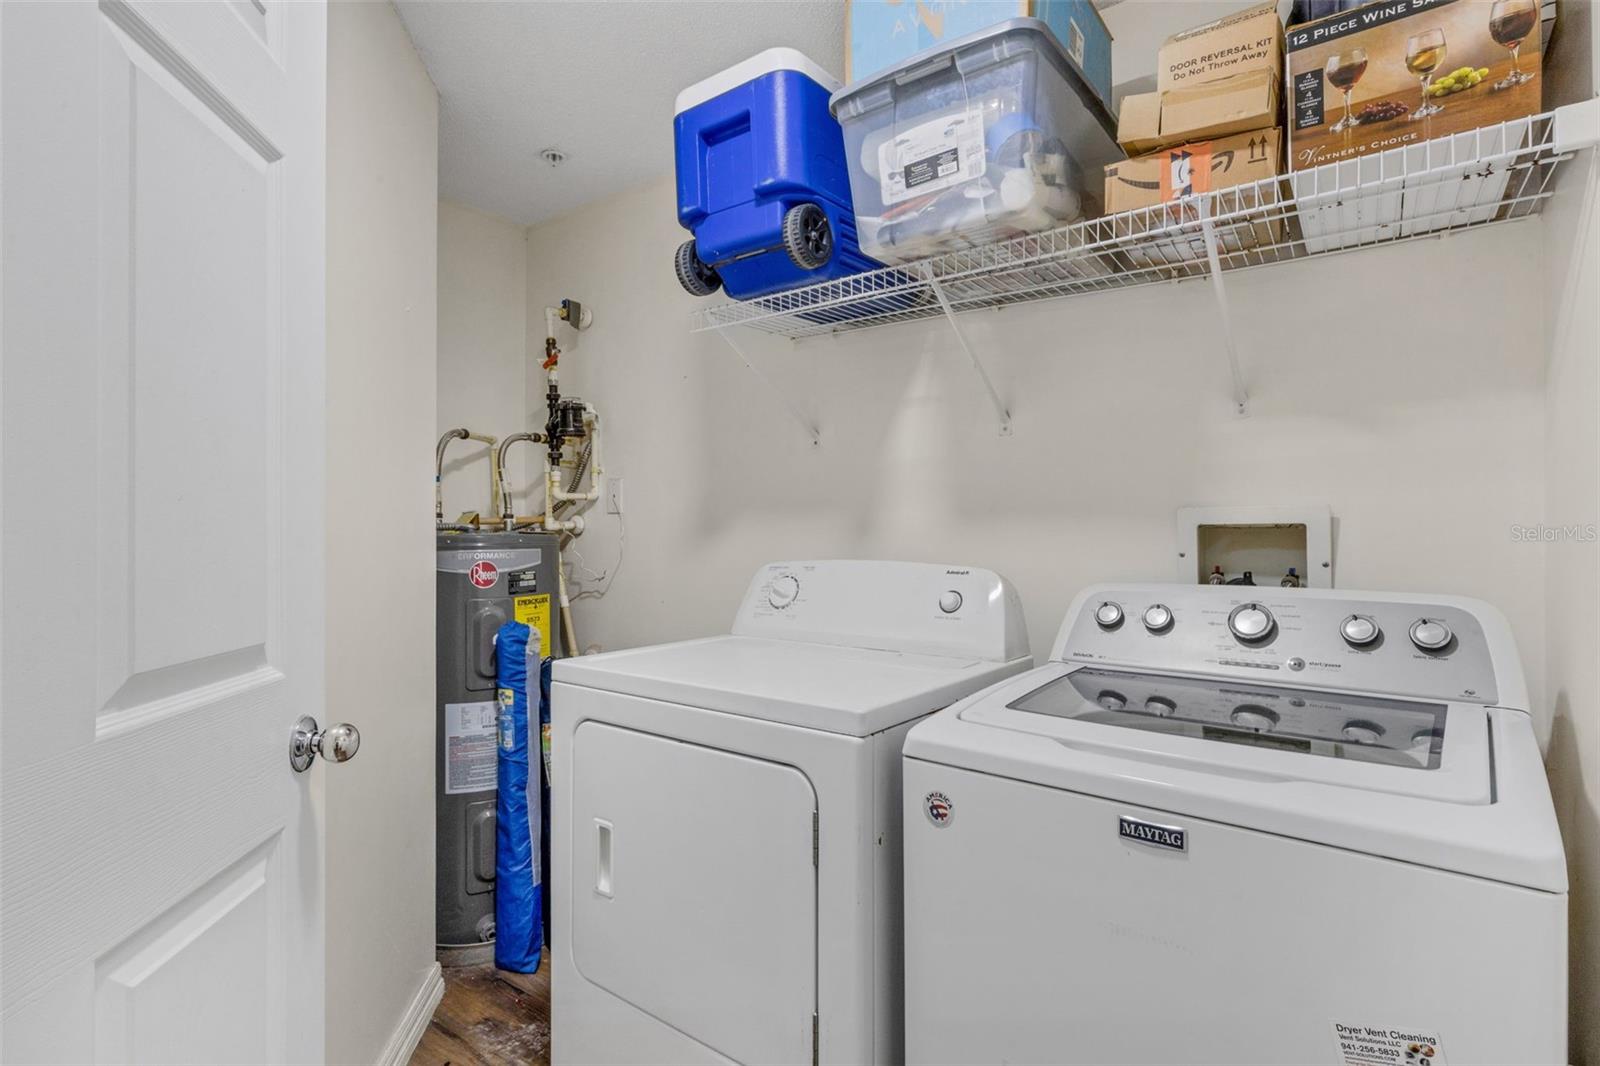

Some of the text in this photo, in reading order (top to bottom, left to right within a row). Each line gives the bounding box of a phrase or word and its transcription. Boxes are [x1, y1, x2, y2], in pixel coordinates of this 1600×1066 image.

[1293, 34, 1308, 46] 12
[1313, 18, 1357, 39] PIECE
[1362, 3, 1406, 24] WINE
[1169, 37, 1273, 73] DOOR REVERSAL KIT
[1173, 49, 1268, 81] Do Not Throw Away
[1298, 132, 1418, 166] VINTNER'S CHOICE
[473, 560, 497, 584] Rheem
[1121, 821, 1182, 846] MAYTAG
[1335, 1023, 1437, 1045] Dryer Vent Cleaning
[1338, 1033, 1353, 1041] Vent
[1354, 1035, 1387, 1046] Solutions
[1340, 1042, 1400, 1057] 941-256-5833
